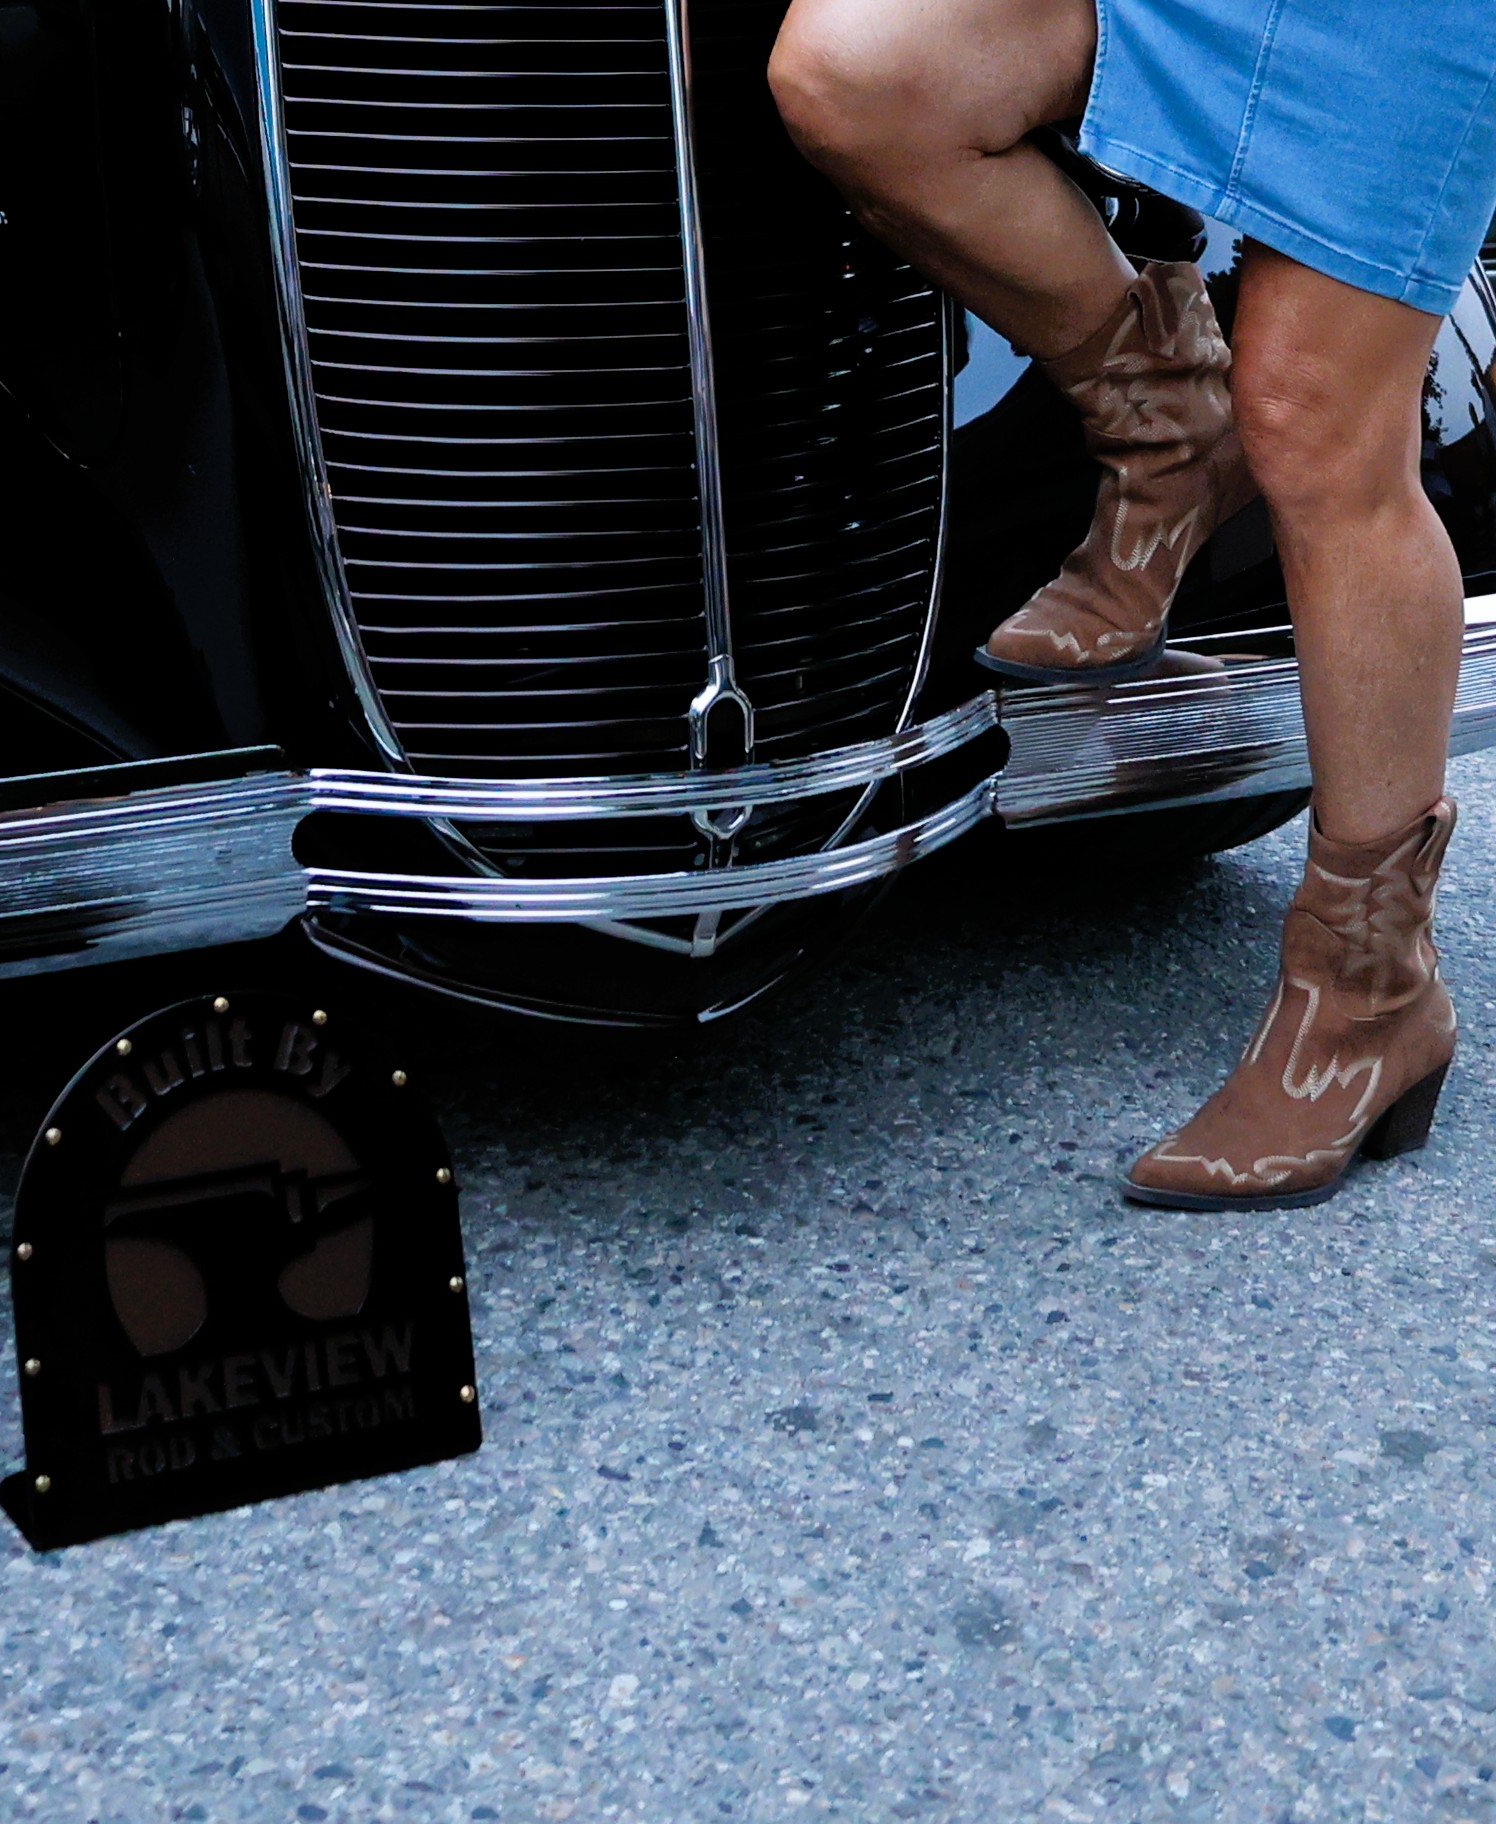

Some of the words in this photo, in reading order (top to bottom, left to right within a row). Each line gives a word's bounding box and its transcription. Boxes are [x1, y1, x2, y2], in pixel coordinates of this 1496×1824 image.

[93, 1016, 253, 1132] Built
[272, 1019, 356, 1099] By
[96, 1318, 417, 1437] LAKEVIEW
[106, 1430, 198, 1485] ROD
[252, 1383, 418, 1452] CUSTOM
